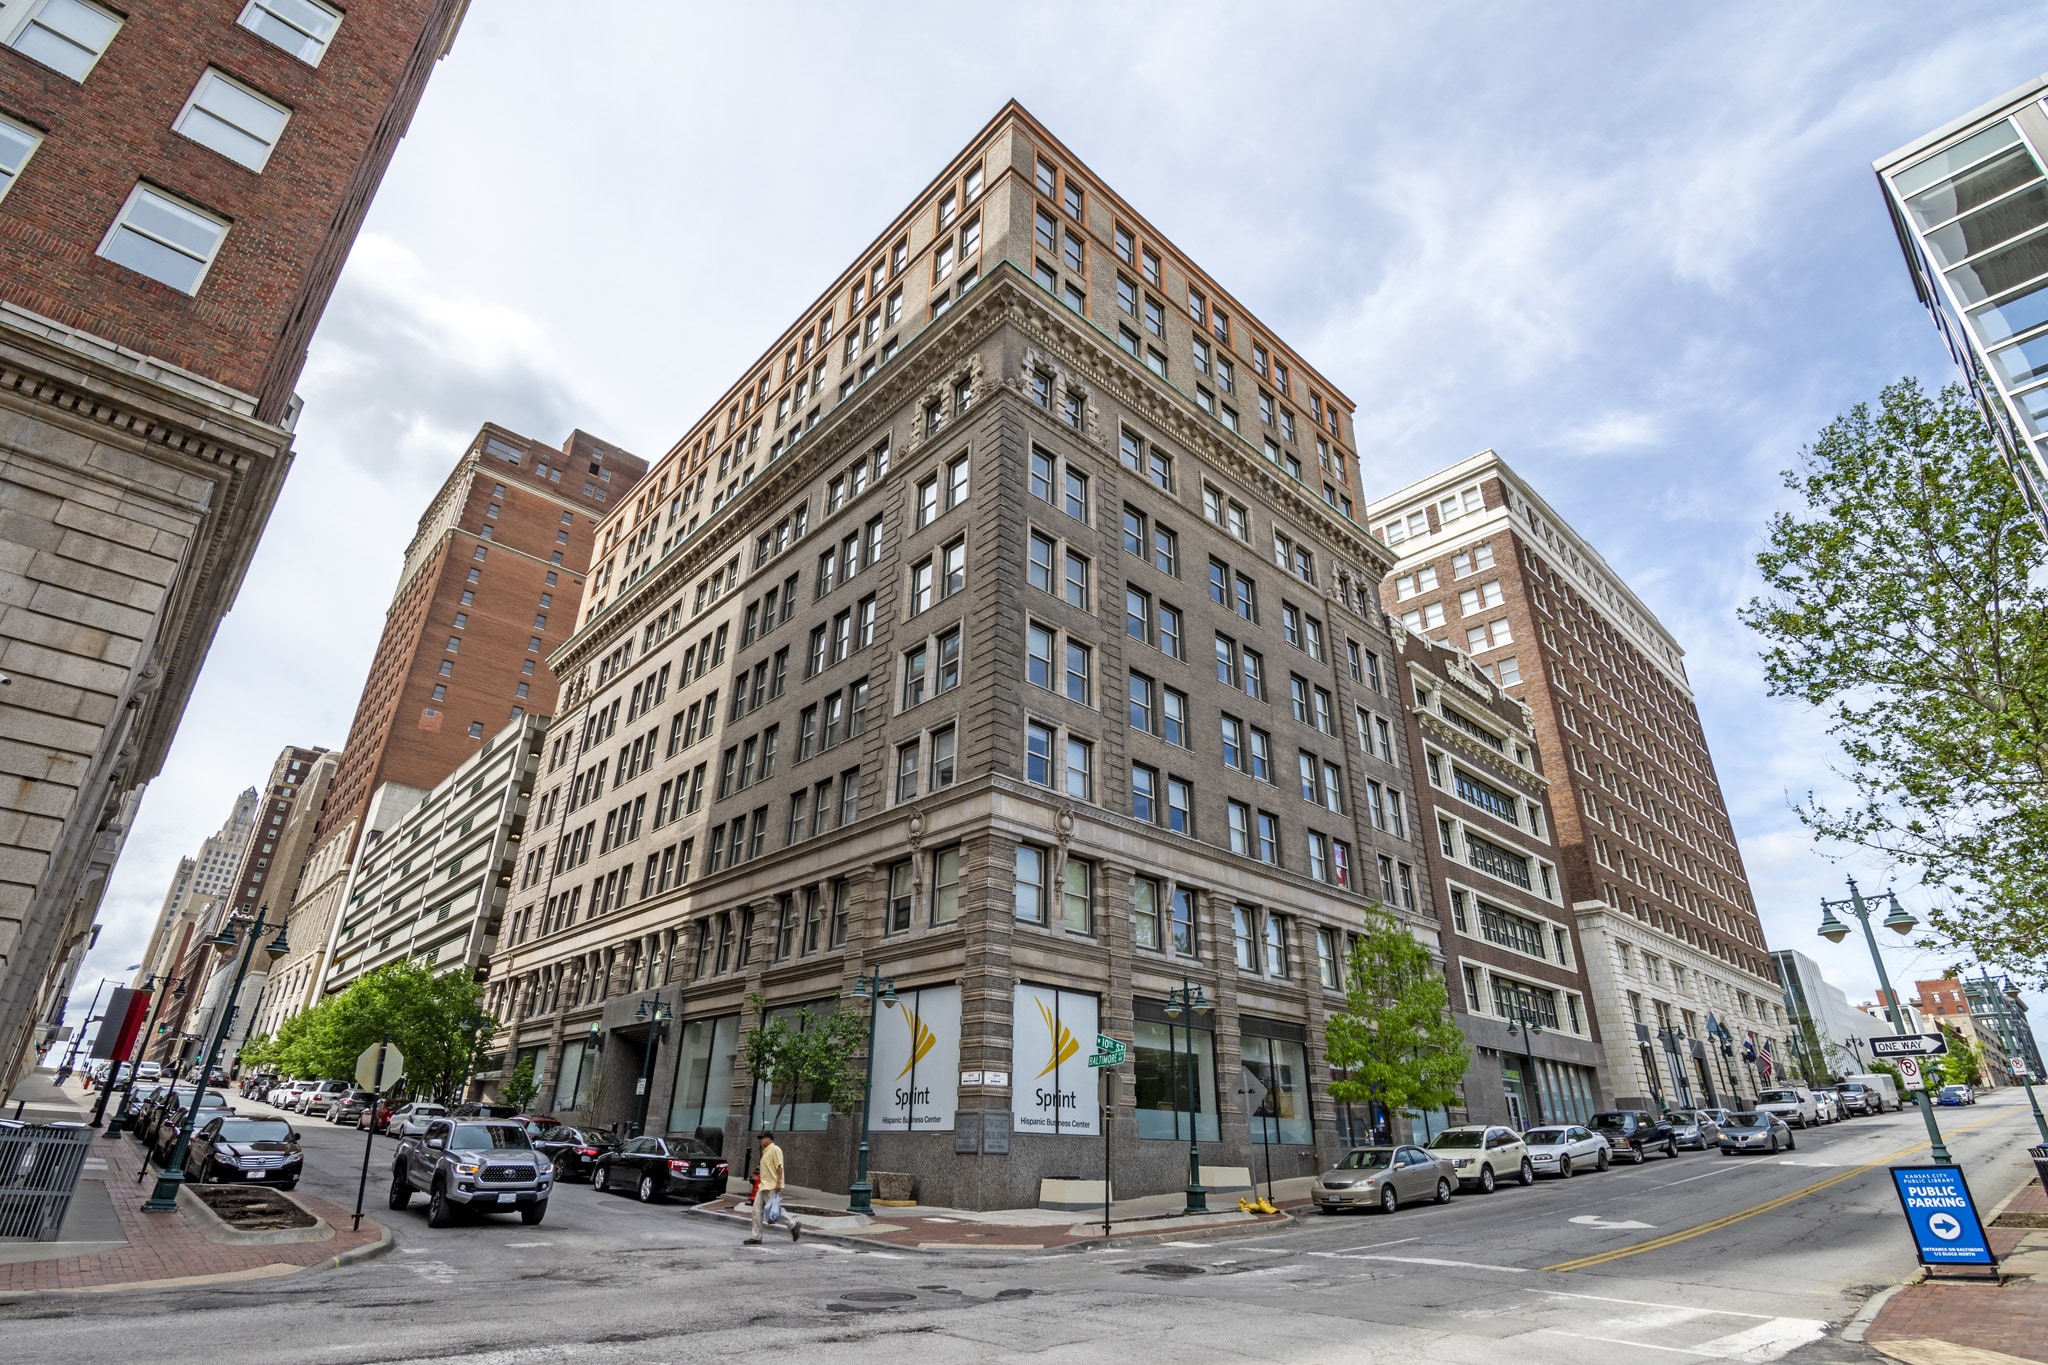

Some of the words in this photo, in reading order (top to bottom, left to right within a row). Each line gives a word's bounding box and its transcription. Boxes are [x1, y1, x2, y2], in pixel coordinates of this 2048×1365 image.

[1102, 1038, 1114, 1048] 10TH
[1878, 1042, 1899, 1051] ONE
[1901, 1041, 1922, 1050] WAY
[1089, 1053, 1118, 1066] BALTIMORE
[895, 1087, 930, 1110] Spint
[1036, 1088, 1076, 1112] Sprint
[882, 1116, 902, 1125] Hispanic
[903, 1116, 924, 1124] Buness
[924, 1115, 942, 1123] Center
[1020, 1117, 1046, 1126] Hispanic
[1046, 1118, 1071, 1127] Busness
[1071, 1120, 1090, 1128] Center
[1908, 1186, 1957, 1196] PUBLIC
[1907, 1197, 1966, 1207] PARKING
